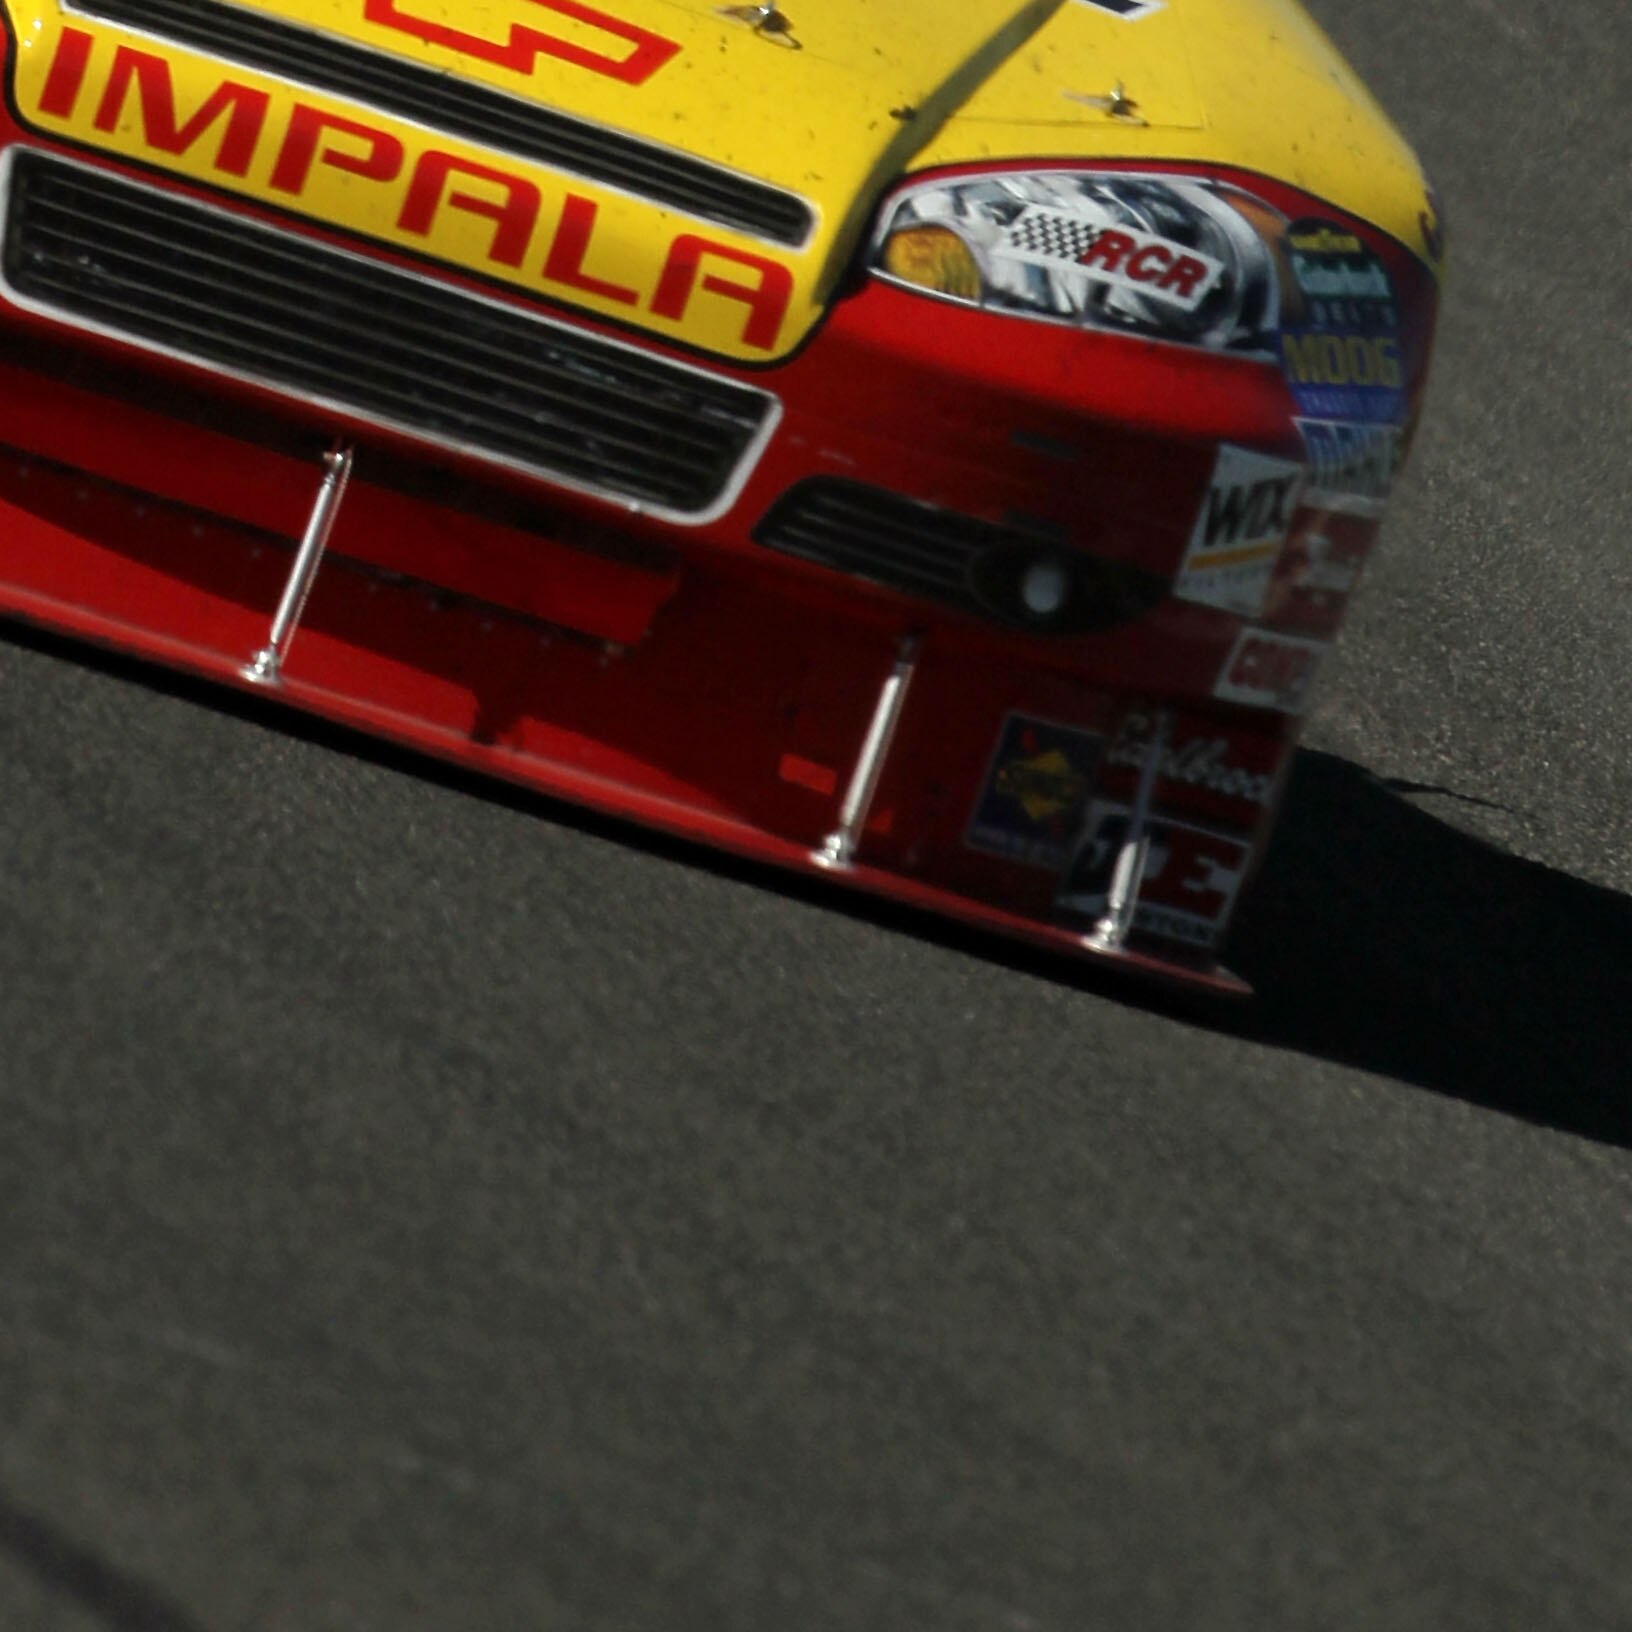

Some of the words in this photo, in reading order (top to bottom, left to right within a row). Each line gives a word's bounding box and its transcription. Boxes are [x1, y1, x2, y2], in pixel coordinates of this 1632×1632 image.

[38, 27, 794, 350] IMPALA
[1080, 229, 1208, 297] RCR
[1281, 334, 1402, 388] MOOG
